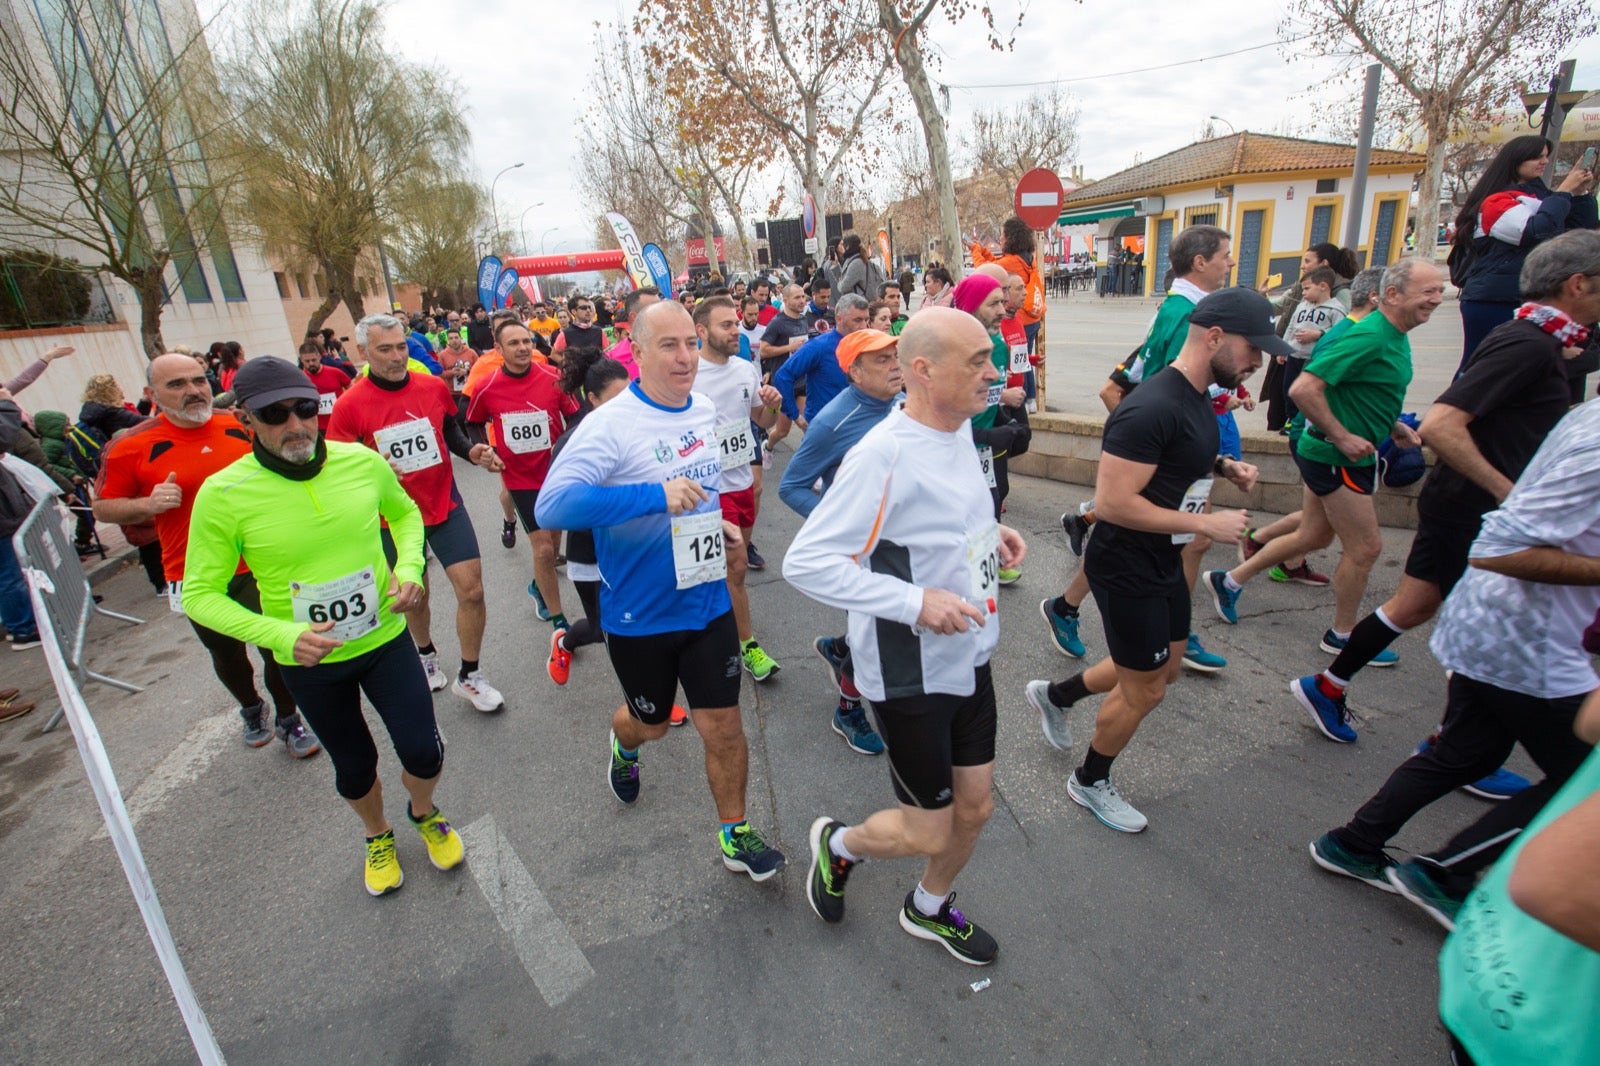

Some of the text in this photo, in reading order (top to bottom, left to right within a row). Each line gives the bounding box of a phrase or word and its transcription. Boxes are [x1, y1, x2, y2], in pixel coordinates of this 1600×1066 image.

[1297, 309, 1325, 324] GAP
[511, 424, 542, 440] 680
[390, 435, 428, 459] 676
[721, 433, 747, 454] 195
[690, 532, 721, 562] 129
[308, 592, 366, 623] 603
